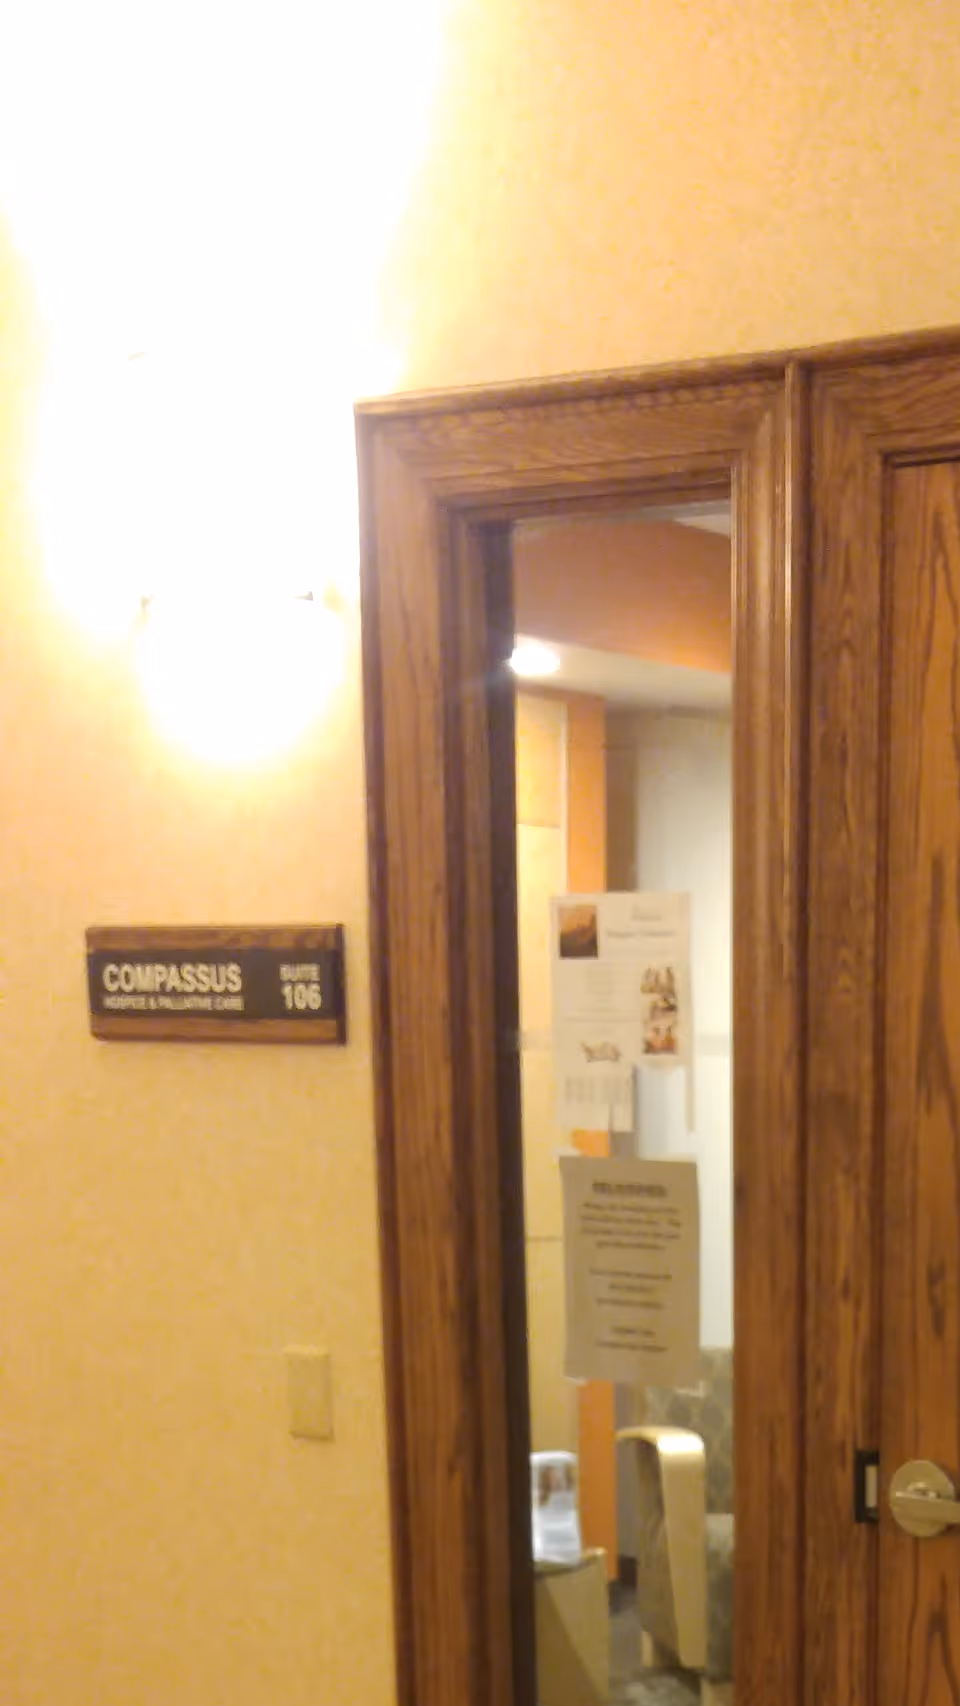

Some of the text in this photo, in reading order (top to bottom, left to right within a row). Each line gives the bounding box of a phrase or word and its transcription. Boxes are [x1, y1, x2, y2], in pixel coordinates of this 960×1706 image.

[103, 963, 242, 993] COMPASSUS
[279, 964, 321, 981] SUITE
[282, 982, 322, 1010] 106
